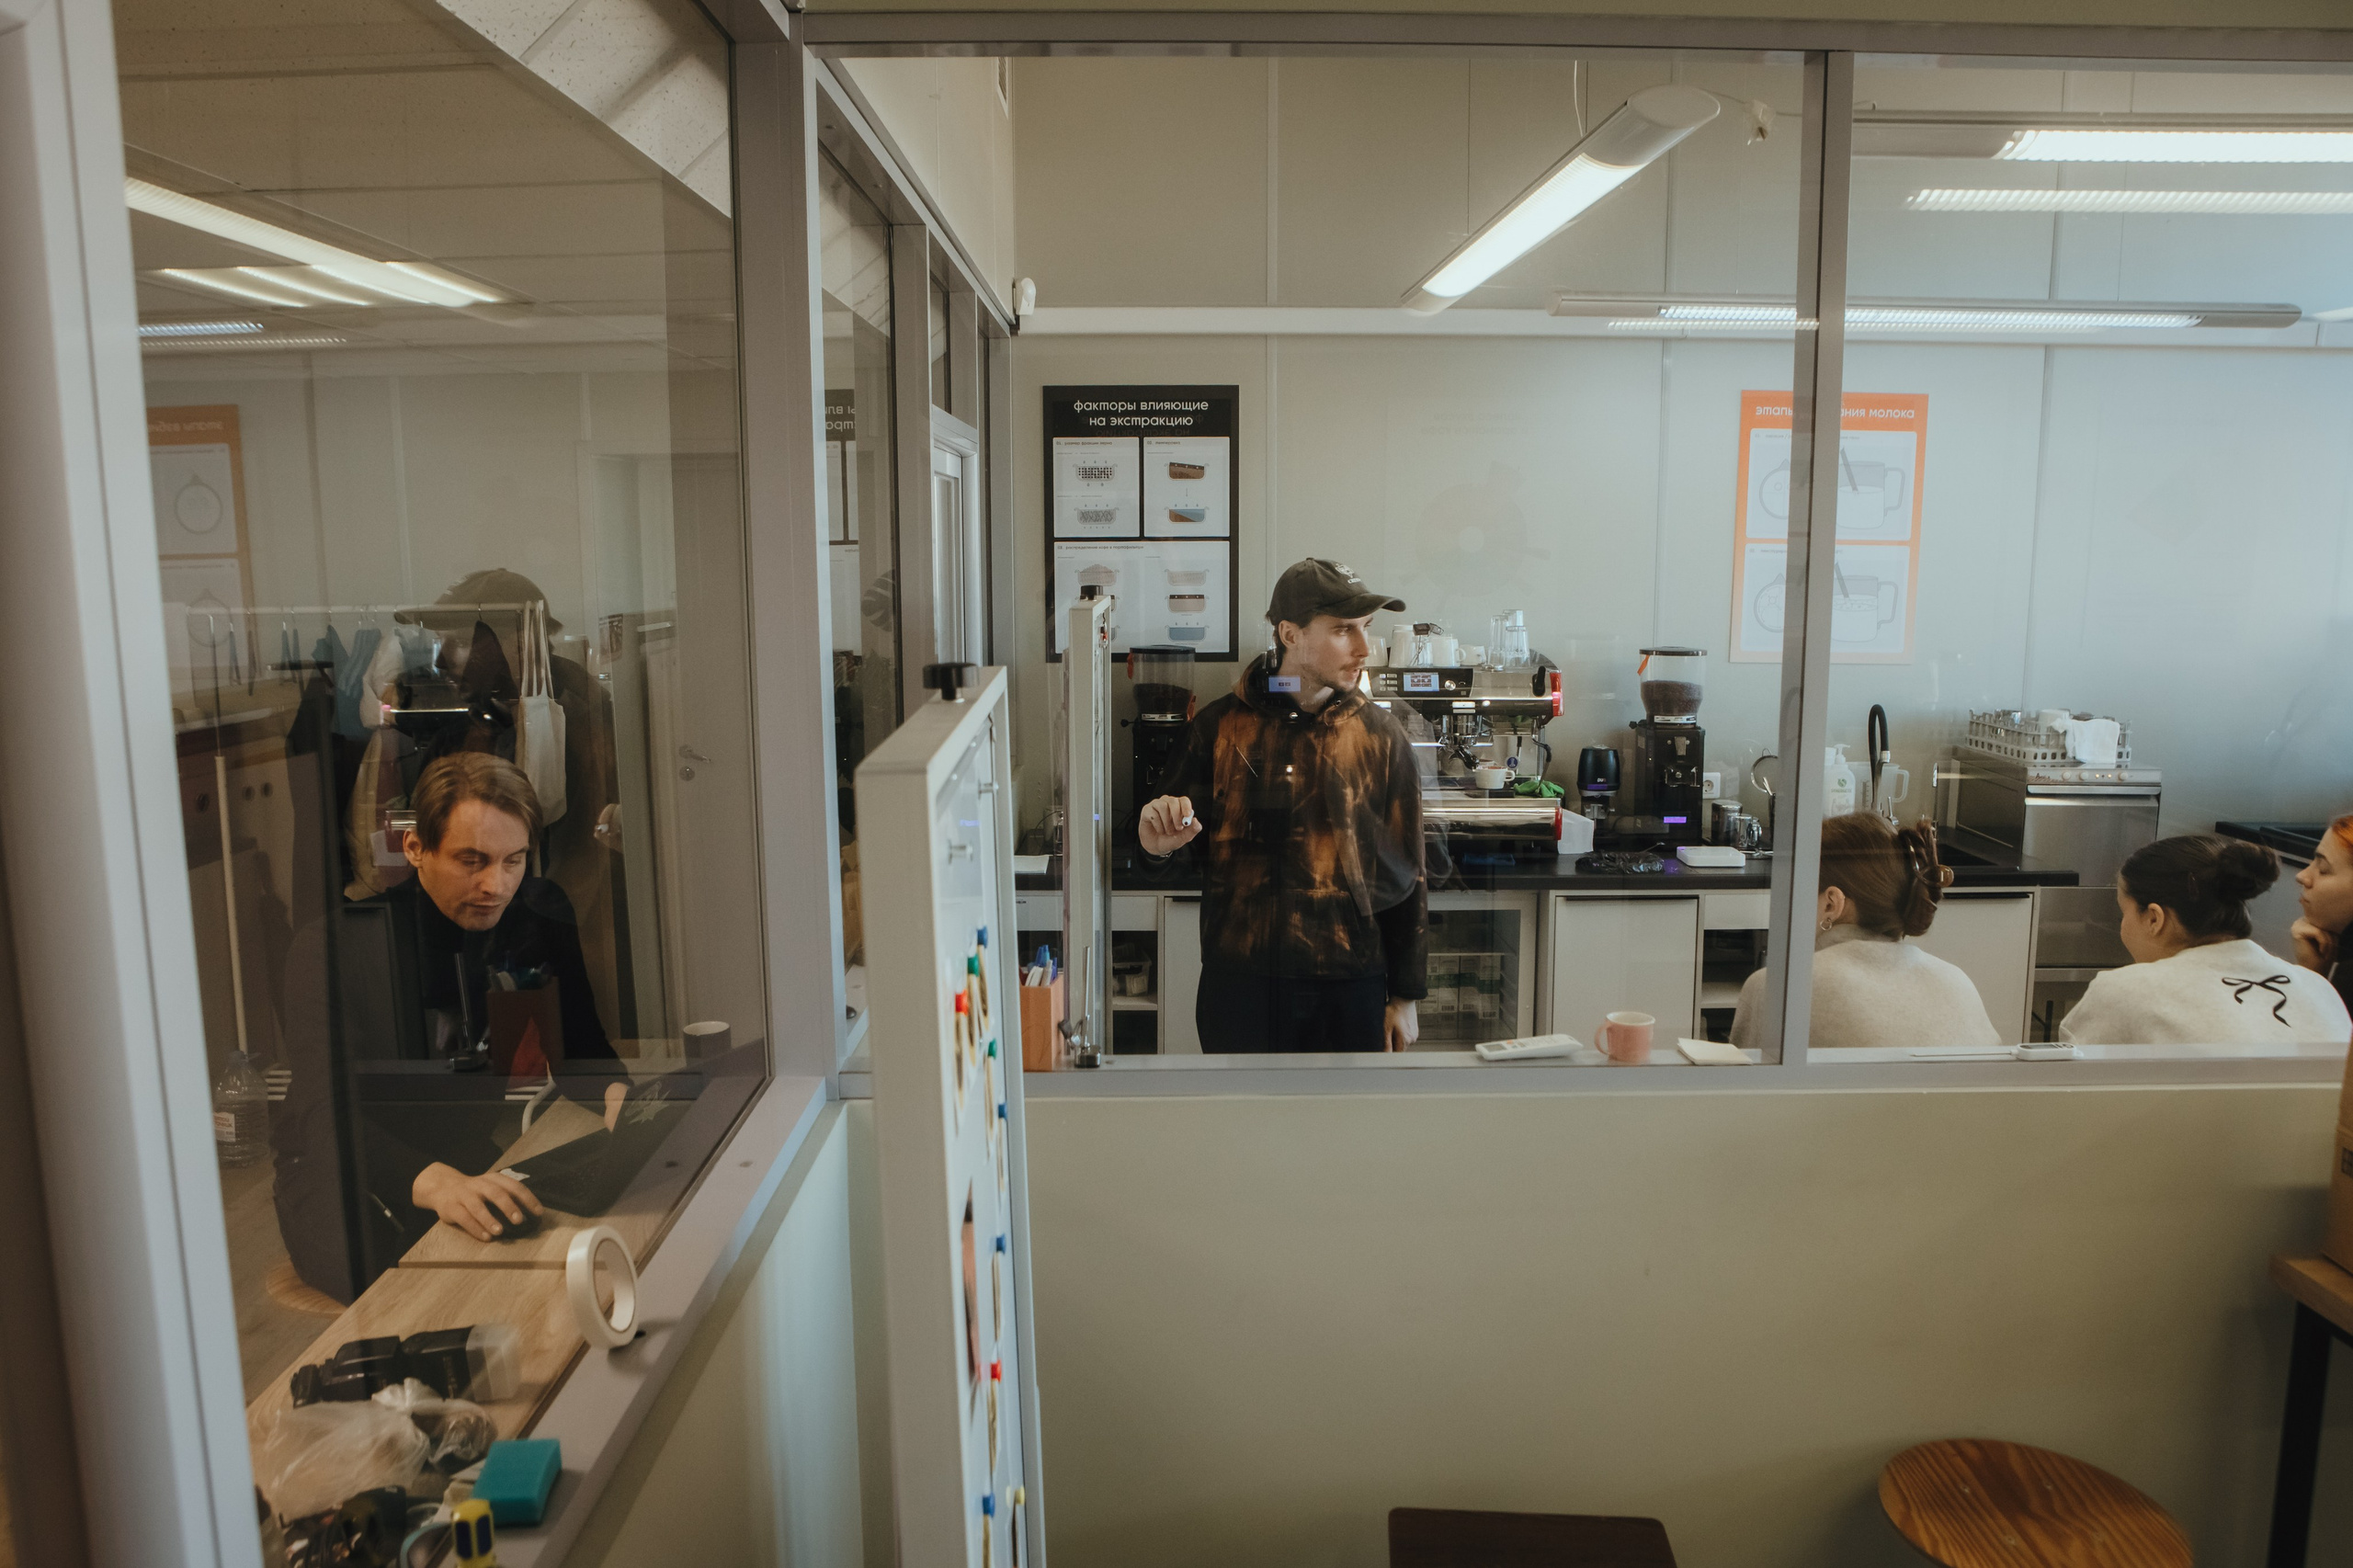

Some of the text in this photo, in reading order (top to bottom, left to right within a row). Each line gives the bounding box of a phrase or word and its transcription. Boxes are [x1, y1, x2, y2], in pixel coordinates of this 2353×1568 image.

[1074, 400, 1209, 413] факторы влияющие
[1869, 408, 1915, 419] молока
[1089, 416, 1194, 428] на экстракцию
